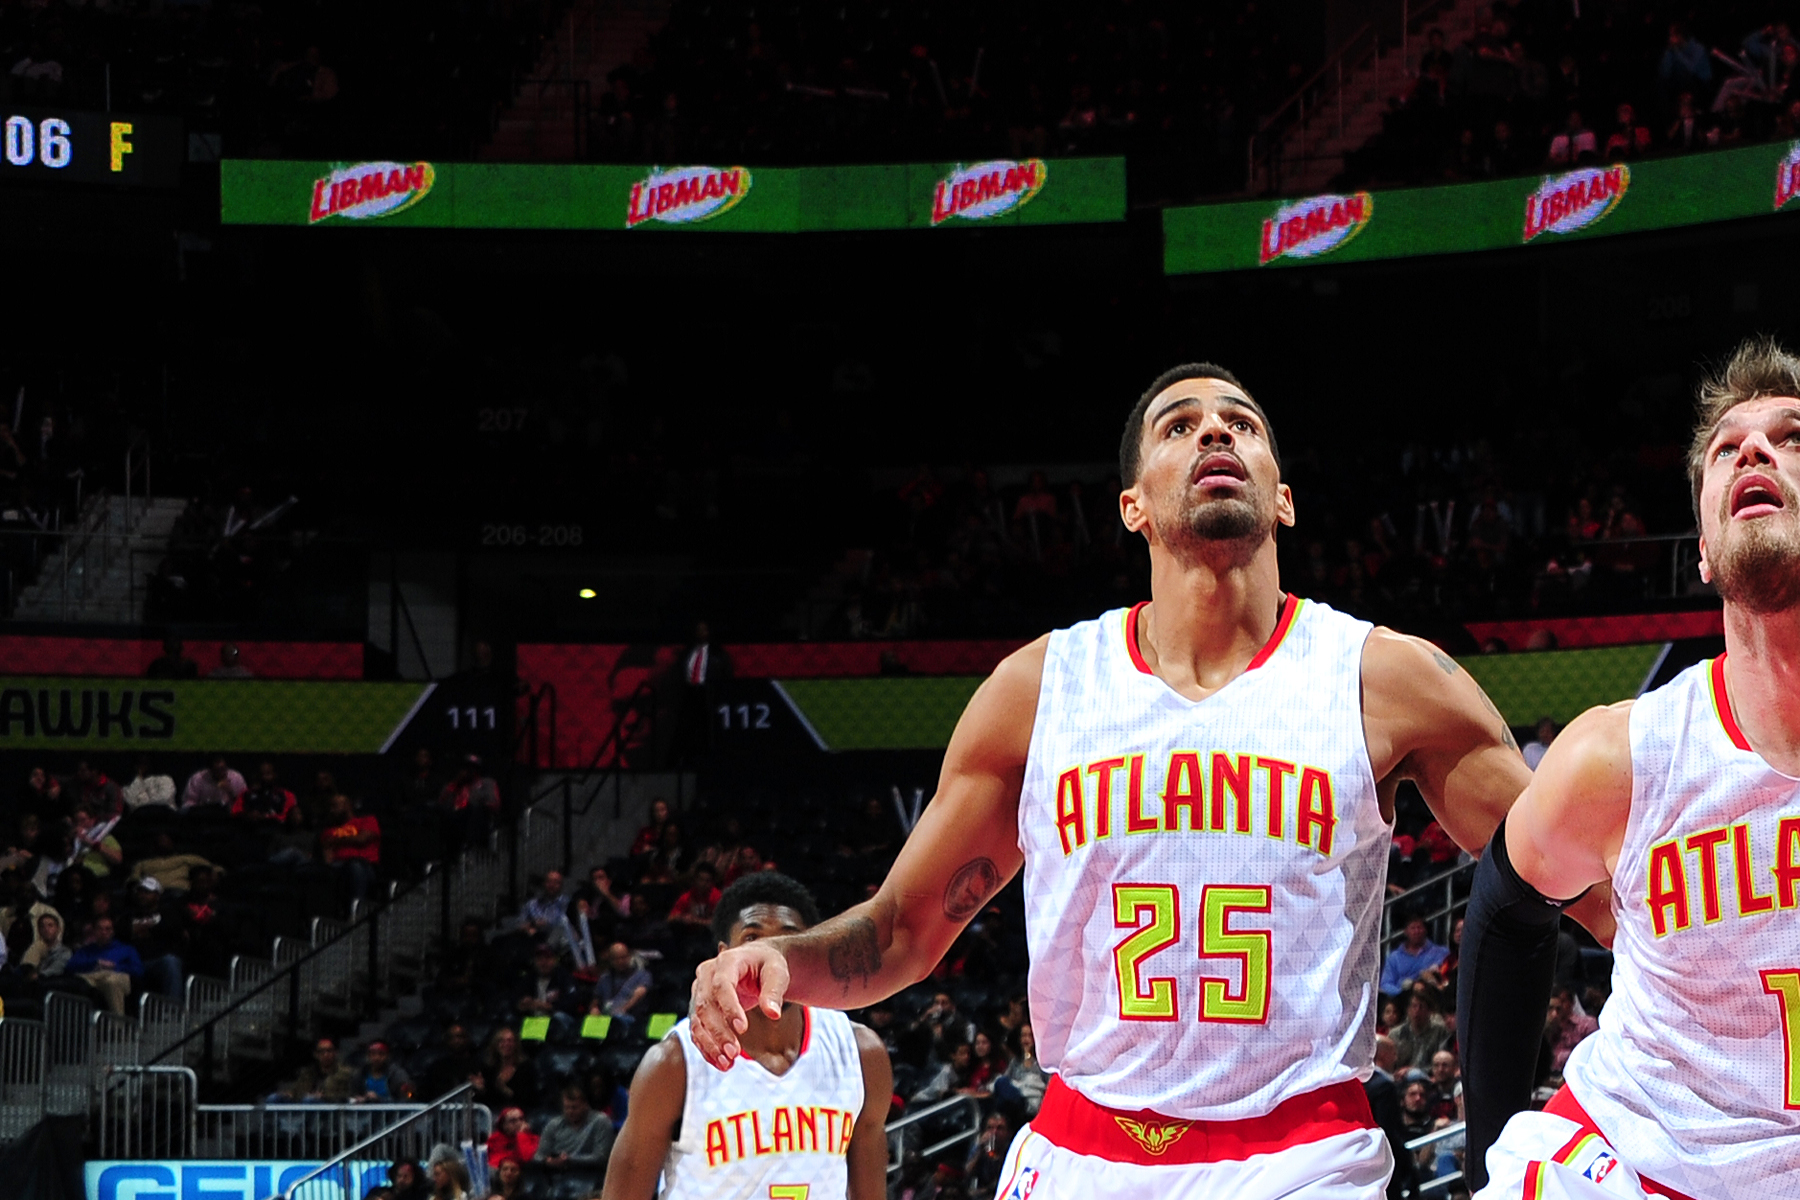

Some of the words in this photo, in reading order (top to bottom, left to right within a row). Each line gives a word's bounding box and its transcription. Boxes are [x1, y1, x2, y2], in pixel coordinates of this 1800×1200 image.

[5, 115, 72, 168] 06
[110, 121, 133, 172] F
[310, 163, 427, 223] LIBMAN
[627, 170, 743, 227] LIBMAN
[932, 161, 1041, 225] LIBMAN
[1524, 165, 1629, 241] LIBMAN
[1260, 192, 1369, 265] LIBMAN
[479, 407, 529, 432] 207
[482, 524, 584, 547] 206-208
[0, 687, 176, 739] AWKS
[447, 705, 497, 730] 111
[717, 703, 772, 730] 112
[1055, 751, 1338, 857] ATLANTA
[1111, 882, 1272, 1024] 25
[705, 1105, 854, 1168] ATLANTA
